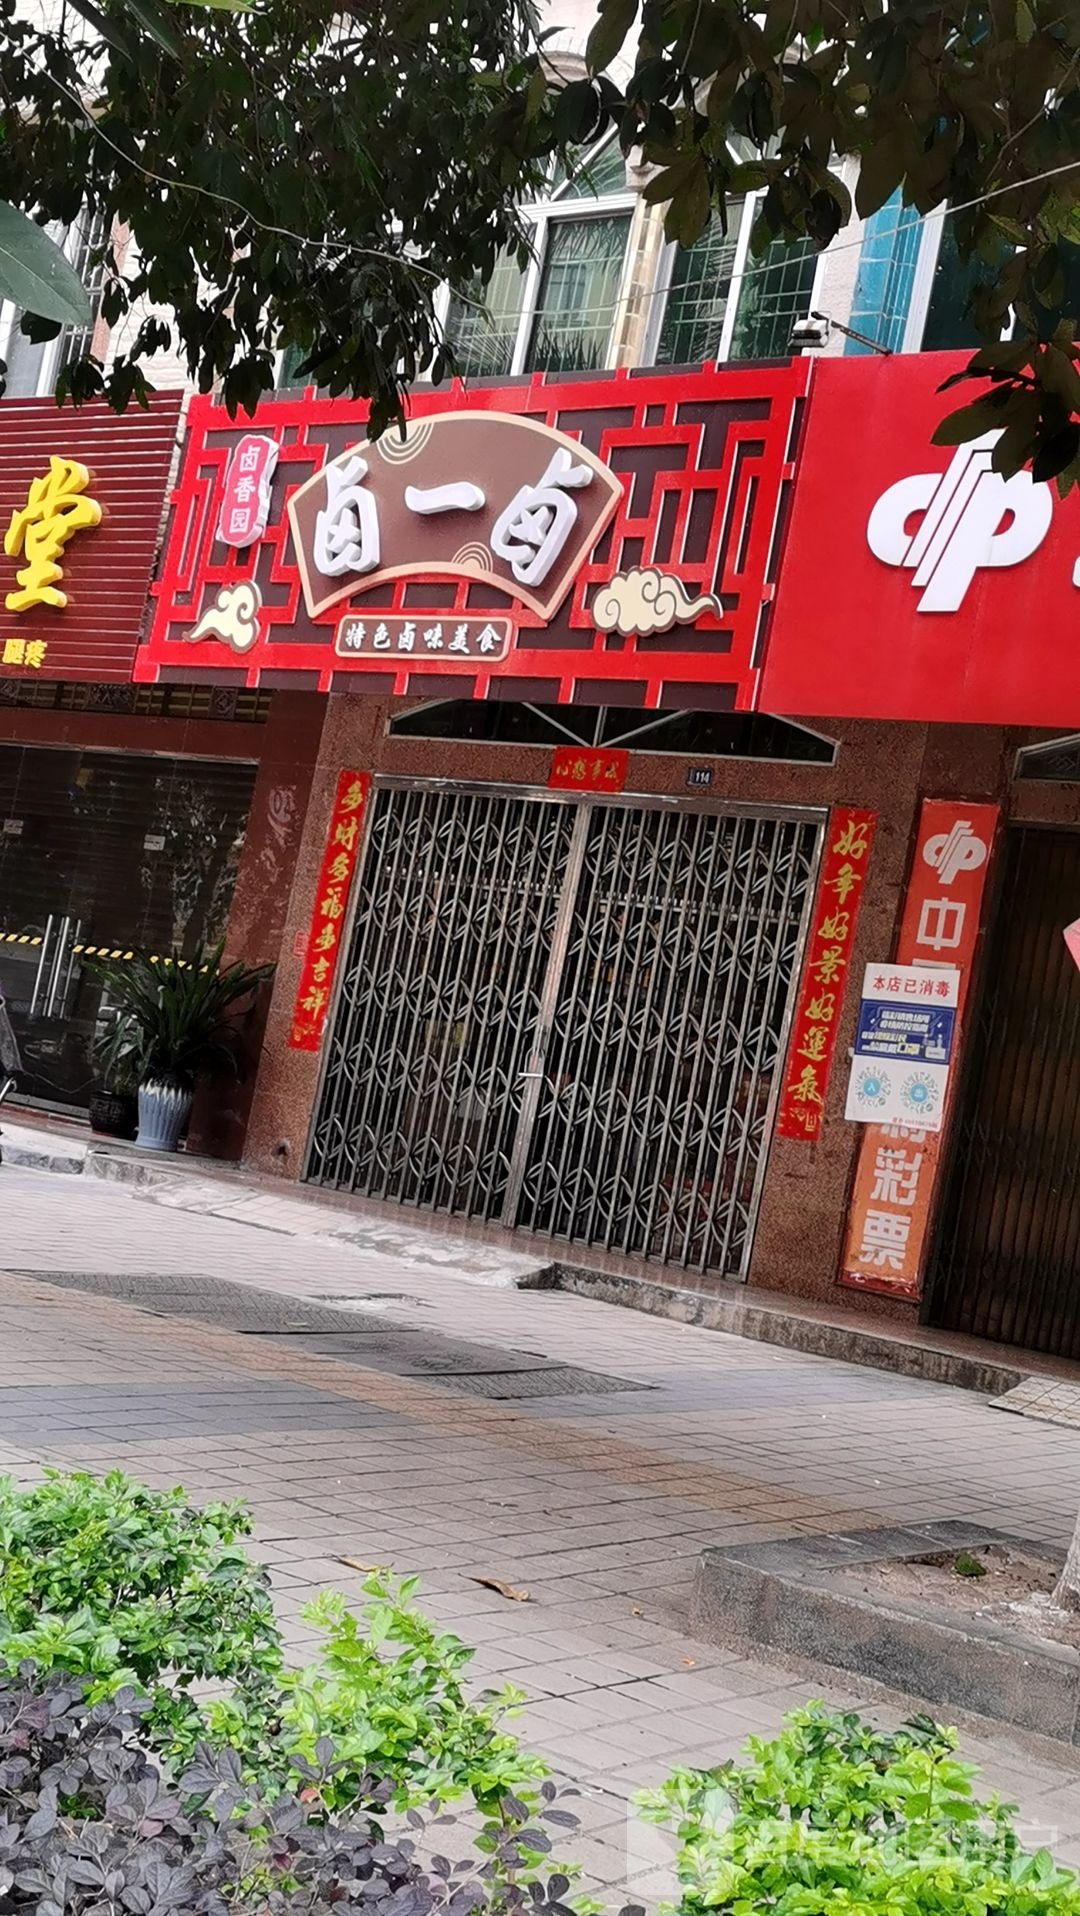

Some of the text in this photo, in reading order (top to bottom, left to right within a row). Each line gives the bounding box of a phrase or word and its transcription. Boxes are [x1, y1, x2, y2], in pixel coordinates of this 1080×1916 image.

[228, 445, 261, 533] 卤香园
[314, 447, 593, 586] 卤一卤
[4, 455, 102, 612] 堂
[345, 621, 502, 654] 特色卤味美食
[695, 771, 710, 784] 114
[873, 974, 951, 998] 本店已消毒
